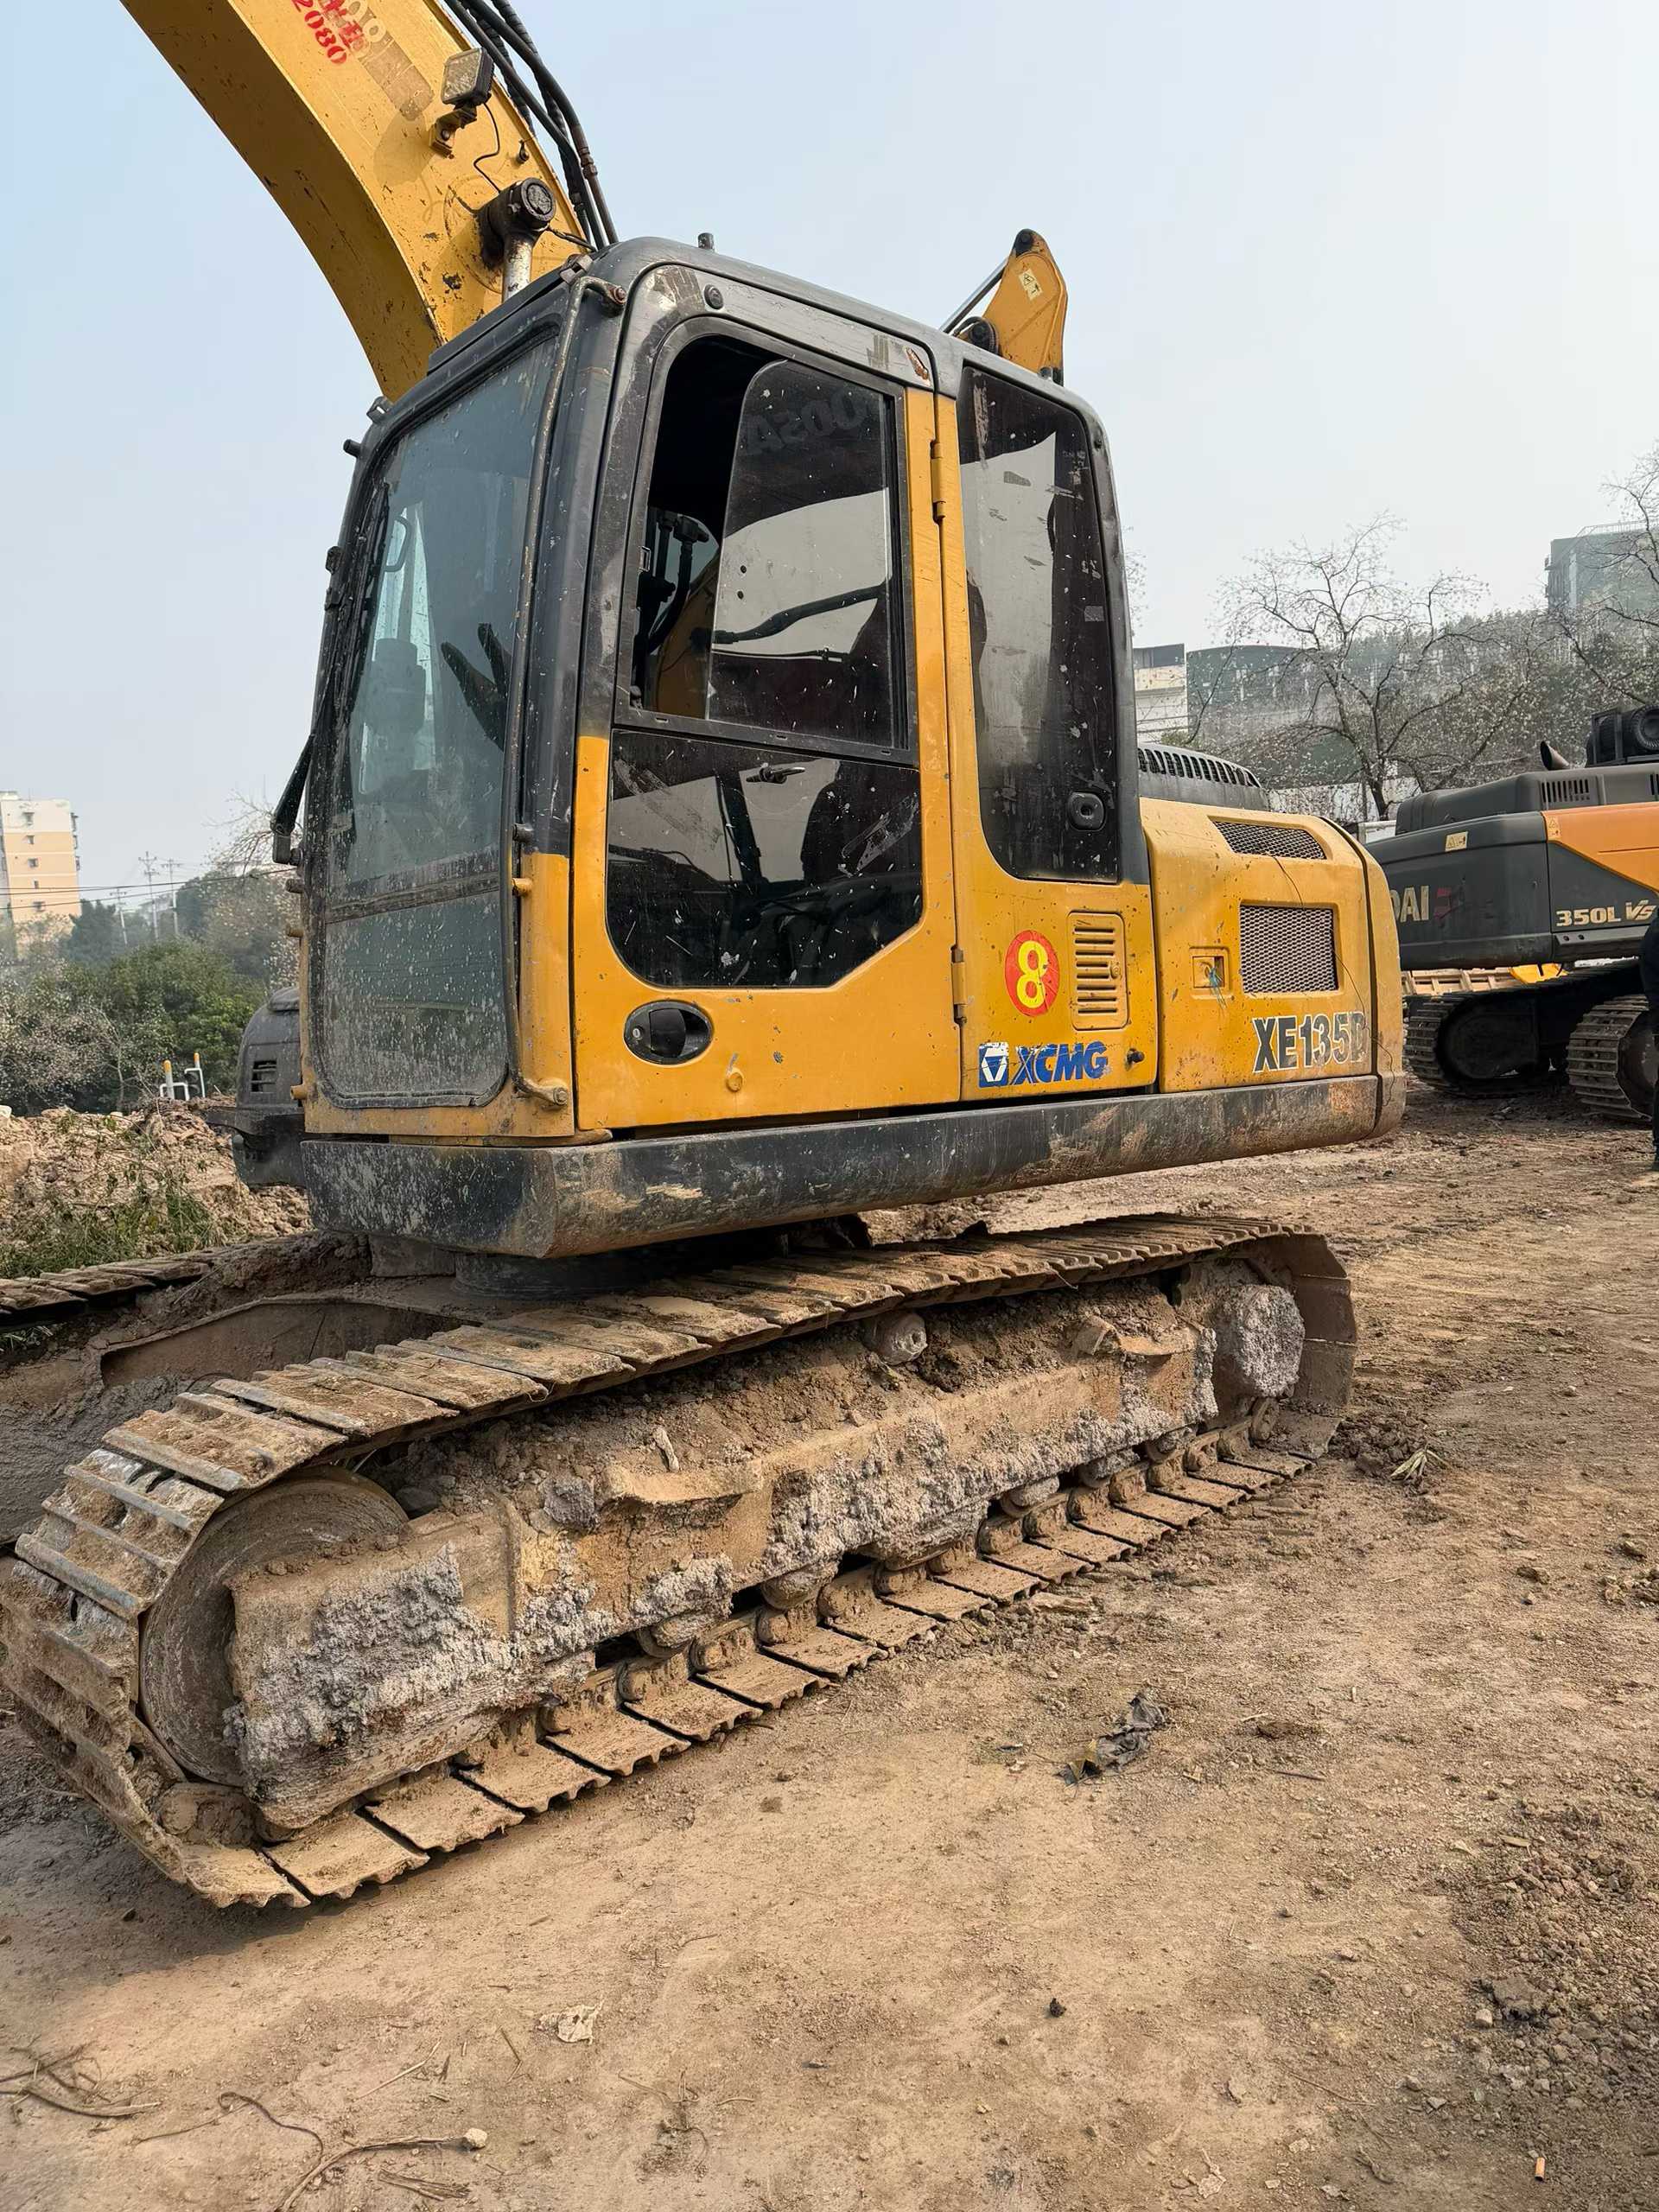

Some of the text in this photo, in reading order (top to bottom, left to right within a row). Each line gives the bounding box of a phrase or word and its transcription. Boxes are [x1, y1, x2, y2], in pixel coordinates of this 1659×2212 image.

[1555, 906, 1622, 927] 350L
[1016, 940, 1049, 1009] 8
[1010, 1040, 1109, 1084] XCMG
